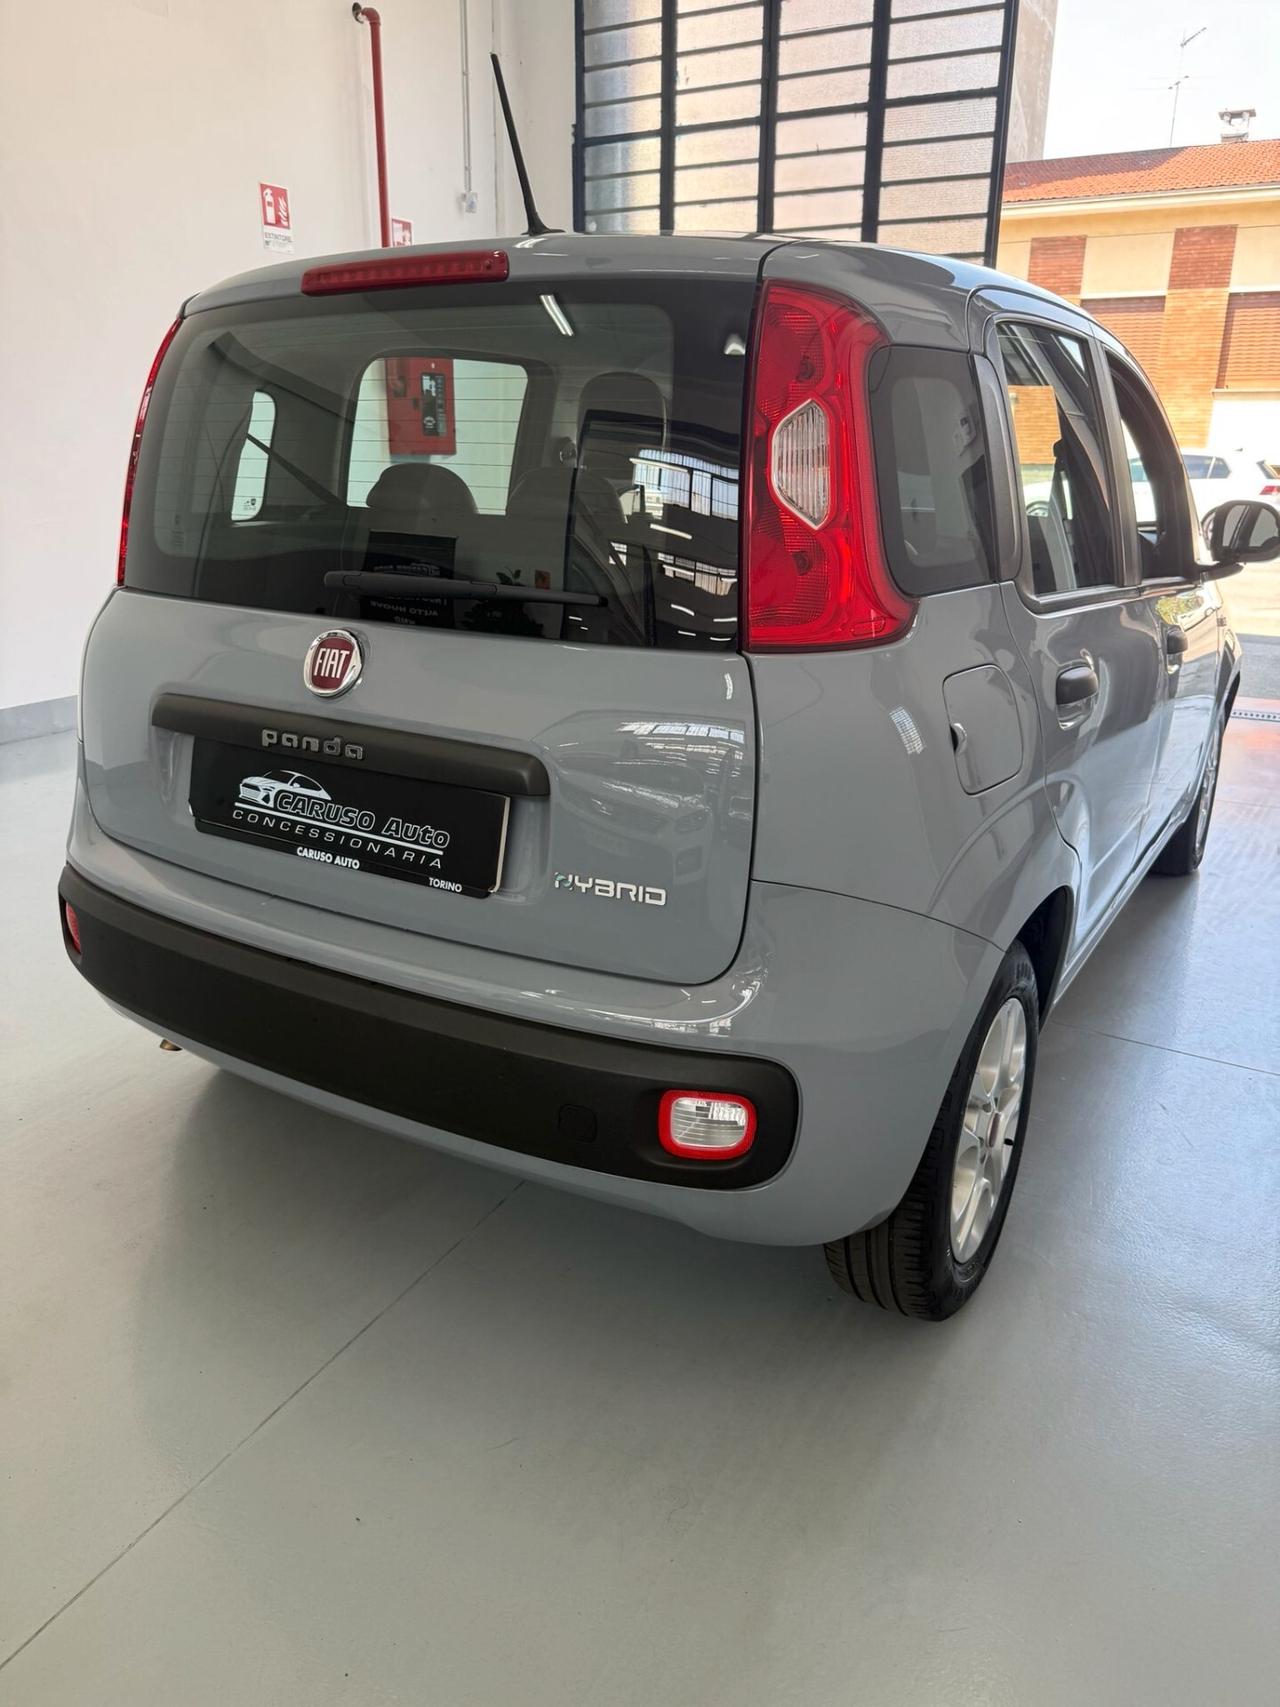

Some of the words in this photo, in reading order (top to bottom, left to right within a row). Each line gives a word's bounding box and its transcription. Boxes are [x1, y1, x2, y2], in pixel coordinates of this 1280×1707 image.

[313, 648, 350, 679] FIAT
[261, 729, 364, 760] panda
[276, 792, 376, 831] CARUSO
[382, 817, 450, 849] Auto
[232, 809, 443, 869] CONCESSIONARIA
[296, 846, 333, 864] CARUSO
[334, 855, 360, 870] AUTO
[428, 876, 462, 893] TORINO
[554, 871, 666, 906] HYBRID
